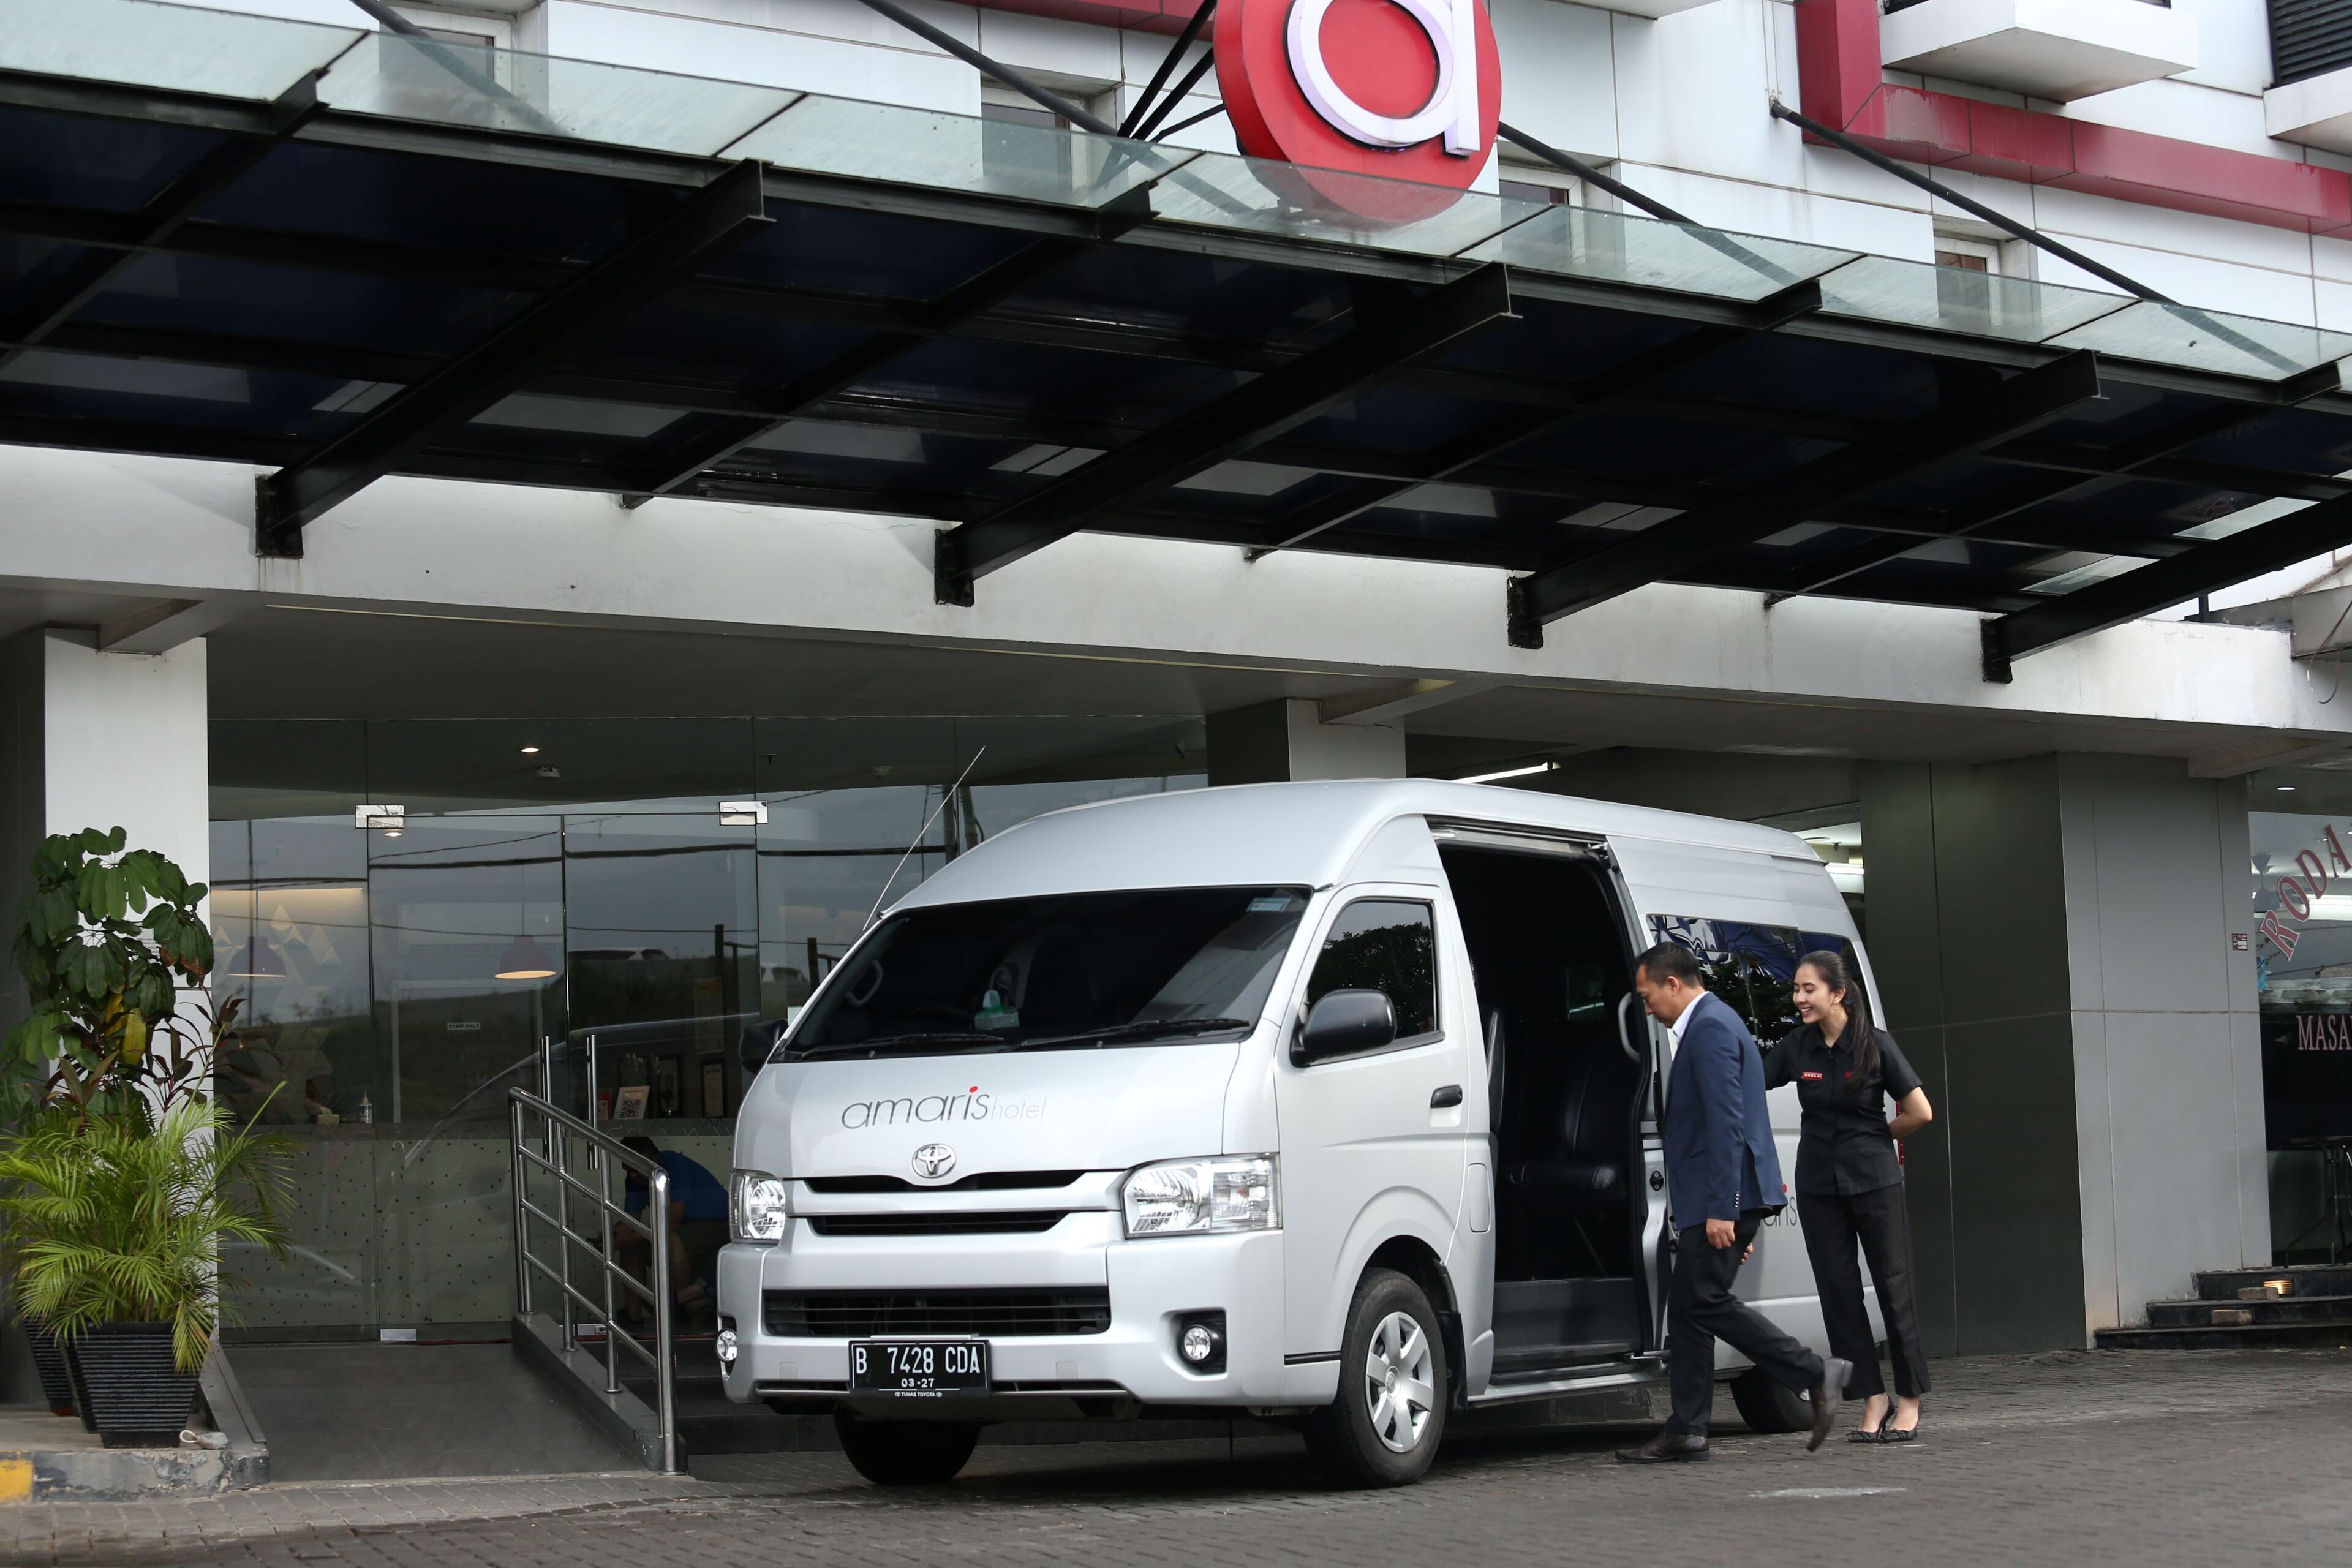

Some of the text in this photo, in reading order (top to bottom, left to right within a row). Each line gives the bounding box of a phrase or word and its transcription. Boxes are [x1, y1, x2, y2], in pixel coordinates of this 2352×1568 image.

[2260, 824, 2352, 962] RODA
[2296, 1014, 2352, 1051] MASA
[842, 1085, 1048, 1129] amaris hotel
[856, 1346, 981, 1374] B 7428 CDA
